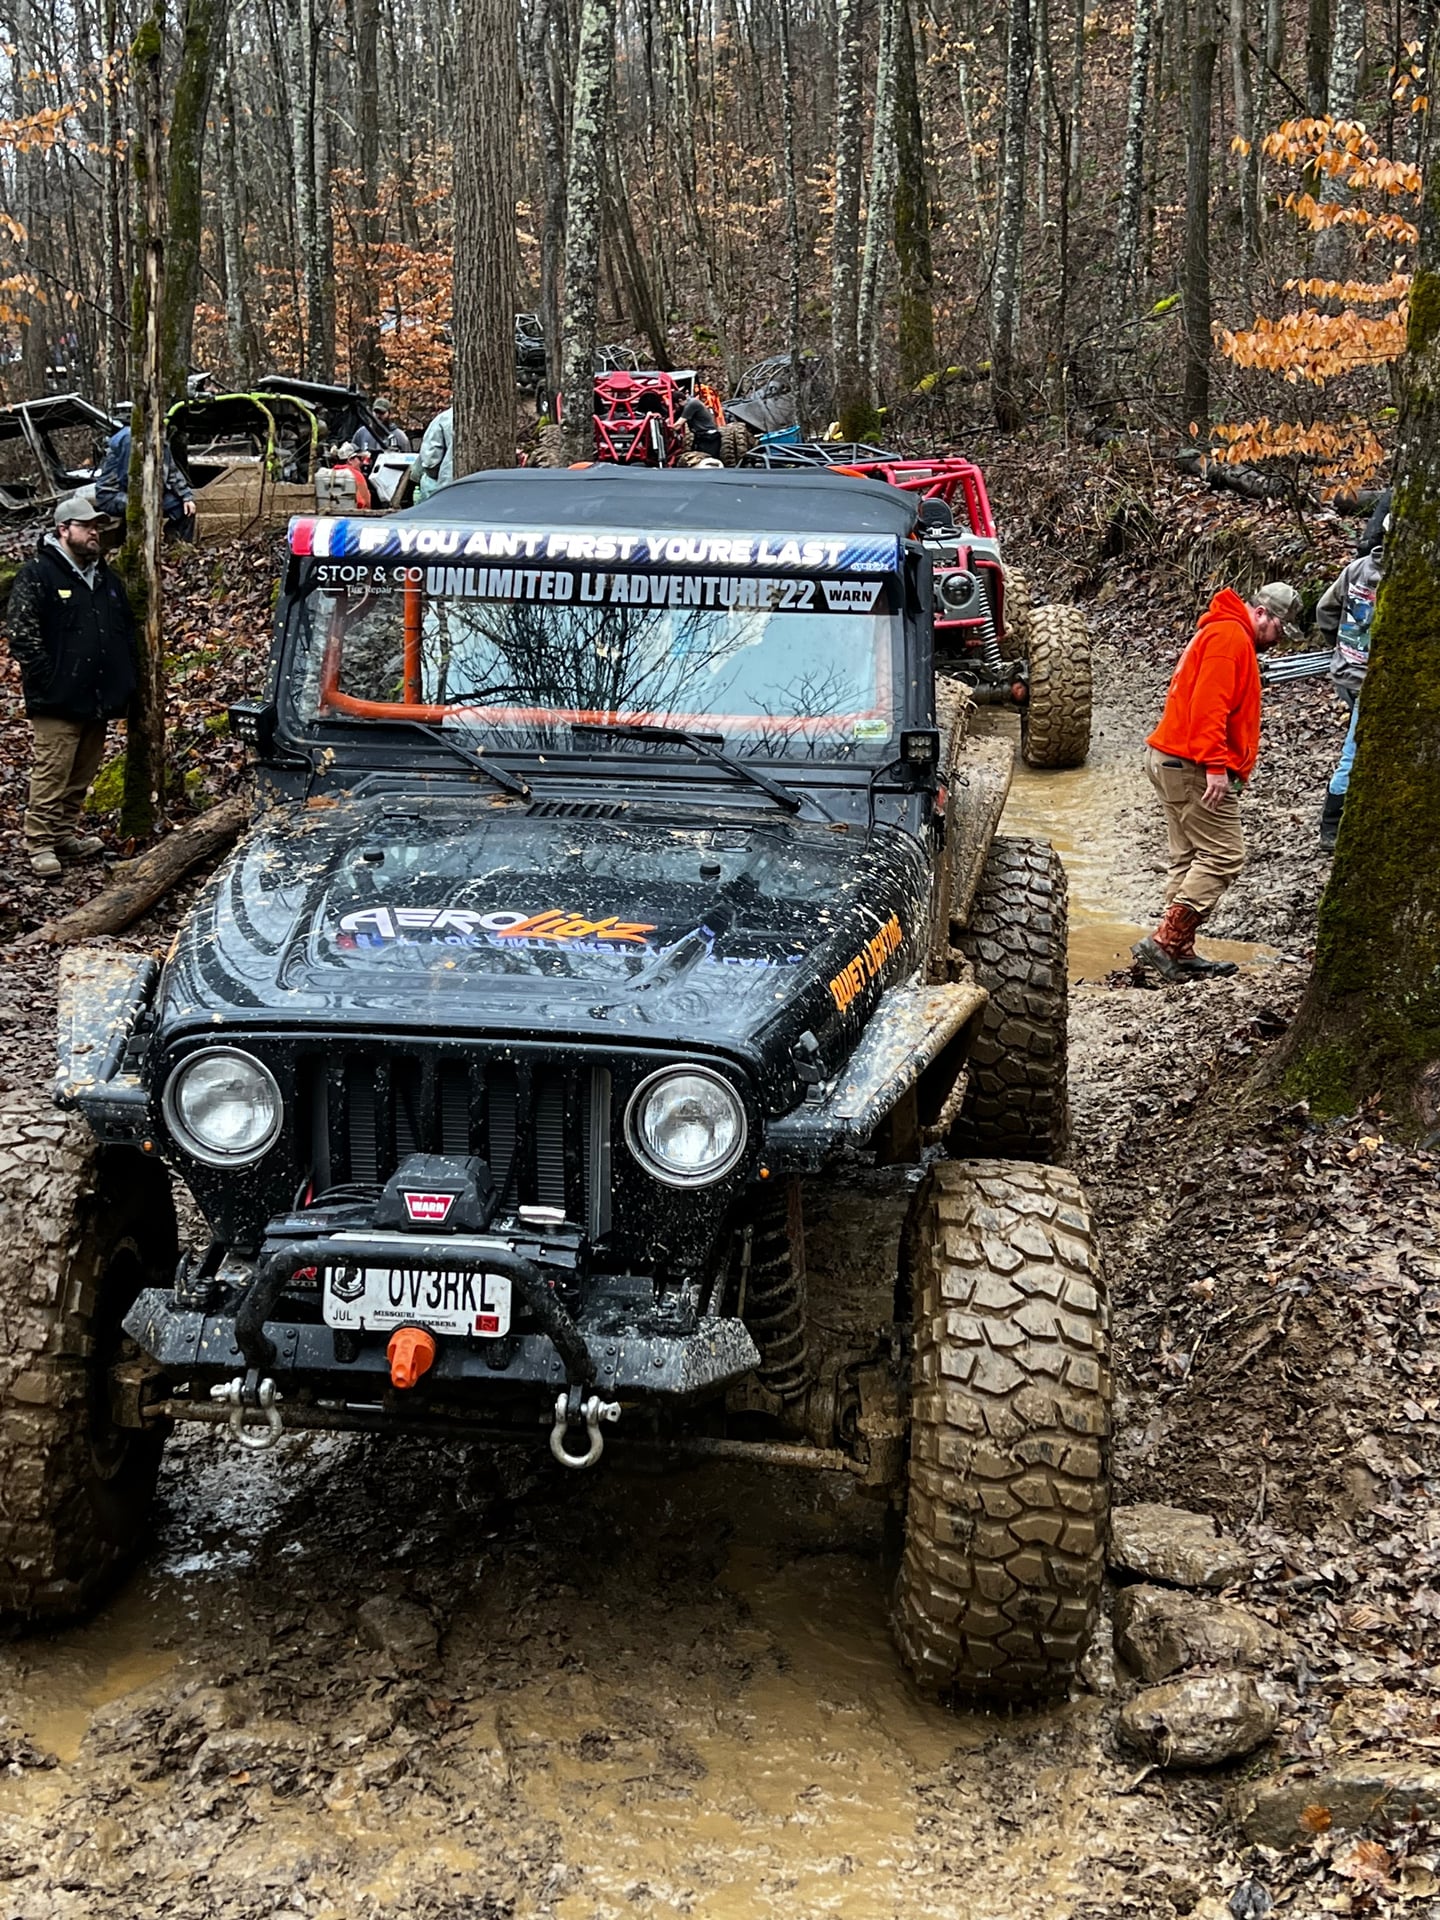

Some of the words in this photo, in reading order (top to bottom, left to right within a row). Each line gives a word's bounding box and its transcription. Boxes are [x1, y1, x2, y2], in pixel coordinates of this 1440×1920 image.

[359, 527, 389, 550] IF
[397, 529, 461, 553] YOU
[547, 534, 638, 560] FIRST
[757, 540, 846, 565] LAST
[317, 565, 368, 581] STOP
[373, 566, 387, 583] &
[393, 566, 423, 582] GO
[365, 585, 392, 594] Repair
[426, 566, 573, 601] UNLIMITED
[580, 572, 606, 602] LJ
[829, 589, 872, 602] WARN
[829, 955, 866, 1015] QUIET
[411, 1201, 446, 1213] WARN
[332, 1309, 352, 1321] JUL
[374, 1310, 415, 1319] MISSOURI
